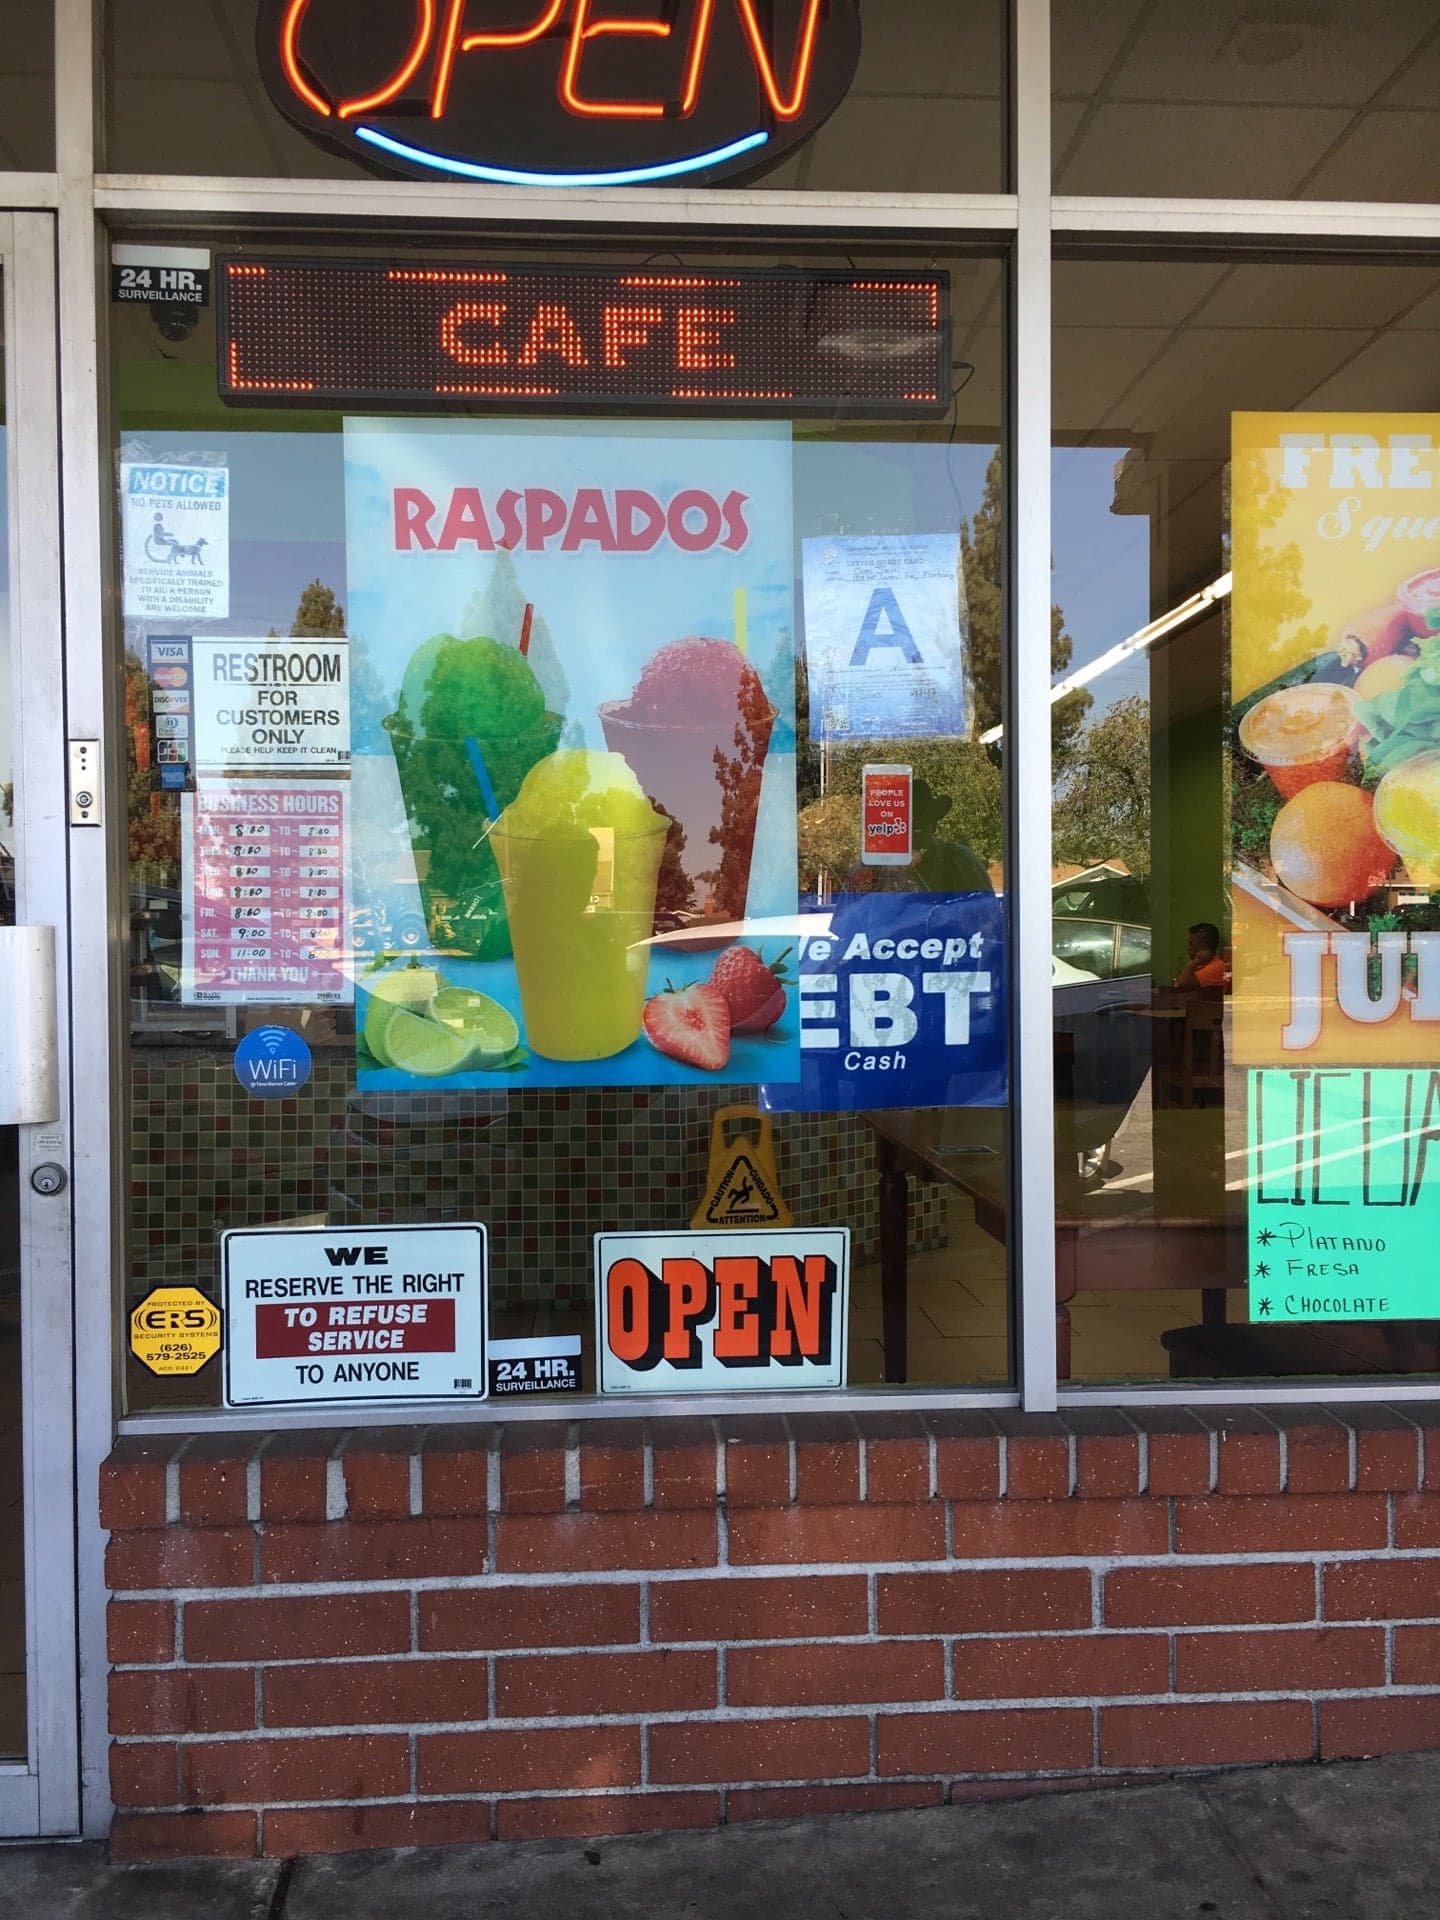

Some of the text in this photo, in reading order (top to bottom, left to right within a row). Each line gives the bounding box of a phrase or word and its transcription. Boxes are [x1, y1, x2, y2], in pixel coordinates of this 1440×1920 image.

[280, 0, 822, 120] OPEN
[121, 269, 202, 291] 24 HR.
[119, 289, 202, 302] SURVEILLANCE
[441, 303, 735, 368] CAFE
[1279, 433, 1440, 489] FRE
[132, 471, 219, 494] NOTICE
[131, 497, 221, 511] NO PETS ALLOWED
[393, 487, 750, 551] RASPADOS
[849, 588, 924, 666] A
[158, 647, 184, 656] VISA
[213, 653, 341, 682] RESTROOM
[258, 691, 297, 706] FOR
[217, 710, 340, 726] CUSTOMERS
[252, 729, 305, 745] ONLY
[870, 789, 904, 797] PEOPLE
[199, 795, 339, 813] BUSINESS HOURS
[869, 799, 892, 807] LOVE
[279, 826, 291, 836] TO
[868, 823, 895, 835] yelp
[279, 846, 291, 856] TO
[280, 867, 291, 876] TO
[280, 887, 291, 897] TO
[200, 908, 217, 917] FRI.
[280, 908, 291, 918] TO
[200, 928, 219, 938] SAT.
[238, 928, 265, 939] 9:00
[280, 929, 291, 938] TO
[200, 949, 221, 959] SUN.
[237, 949, 266, 957] 11:00
[280, 949, 291, 959] TO
[843, 931, 984, 966] Accept
[229, 966, 308, 984] THANK YOU
[799, 970, 992, 1049] EBT
[249, 1058, 297, 1079] WiFi
[844, 1051, 907, 1070] Cash
[711, 1169, 735, 1208] CAUTION
[750, 1169, 774, 1205] CUIDADO
[718, 1214, 767, 1225] ATTENTION
[324, 1246, 388, 1266] WE
[1287, 1259, 1360, 1277] FRESA
[245, 1273, 465, 1298] RESERVE THE RIGHT
[607, 1255, 837, 1371] OPEN
[1285, 1295, 1390, 1315] CHOCOLATE
[146, 1310, 205, 1328] ERS
[284, 1304, 428, 1327] TO REFUSE
[160, 1344, 192, 1352] (626)
[308, 1330, 404, 1351] SERVICE
[146, 1352, 206, 1361] 579-2525
[296, 1362, 419, 1384] TO ANYONE
[497, 1359, 575, 1380] 24 HR.
[496, 1379, 576, 1392] SURVEILLANCE
